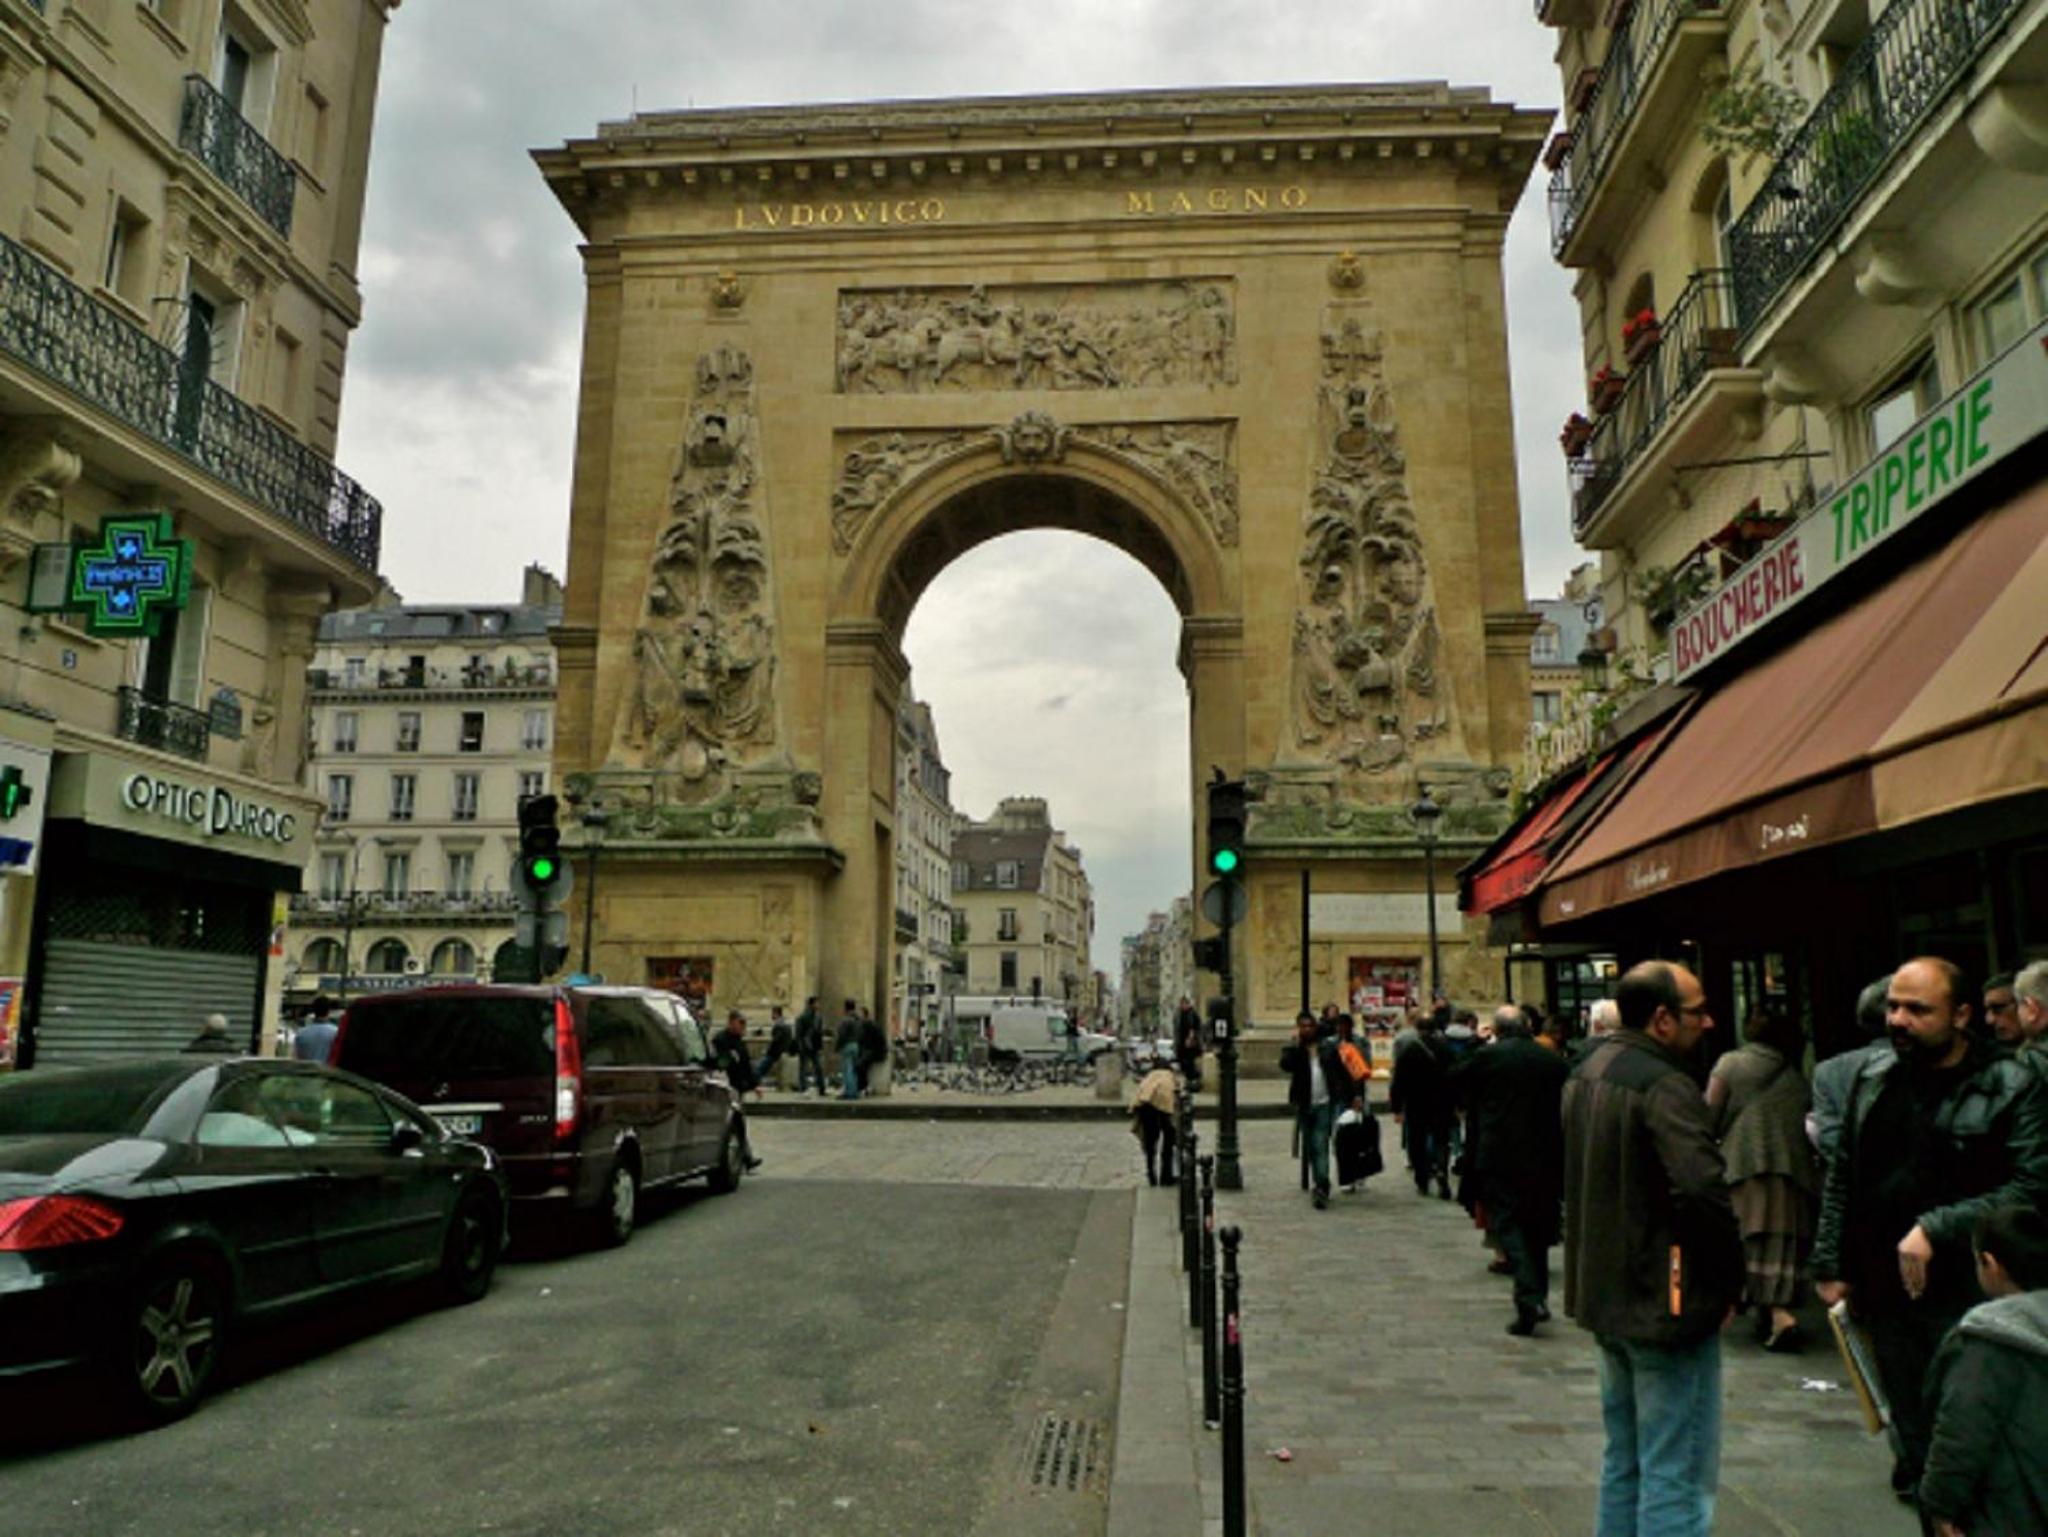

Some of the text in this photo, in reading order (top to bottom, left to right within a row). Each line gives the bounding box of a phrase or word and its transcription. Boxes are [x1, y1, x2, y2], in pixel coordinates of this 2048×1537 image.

[735, 185, 1308, 230] LVDOVICO MAGNO
[1676, 377, 1992, 676] BOUCHERIE TRIPERIE
